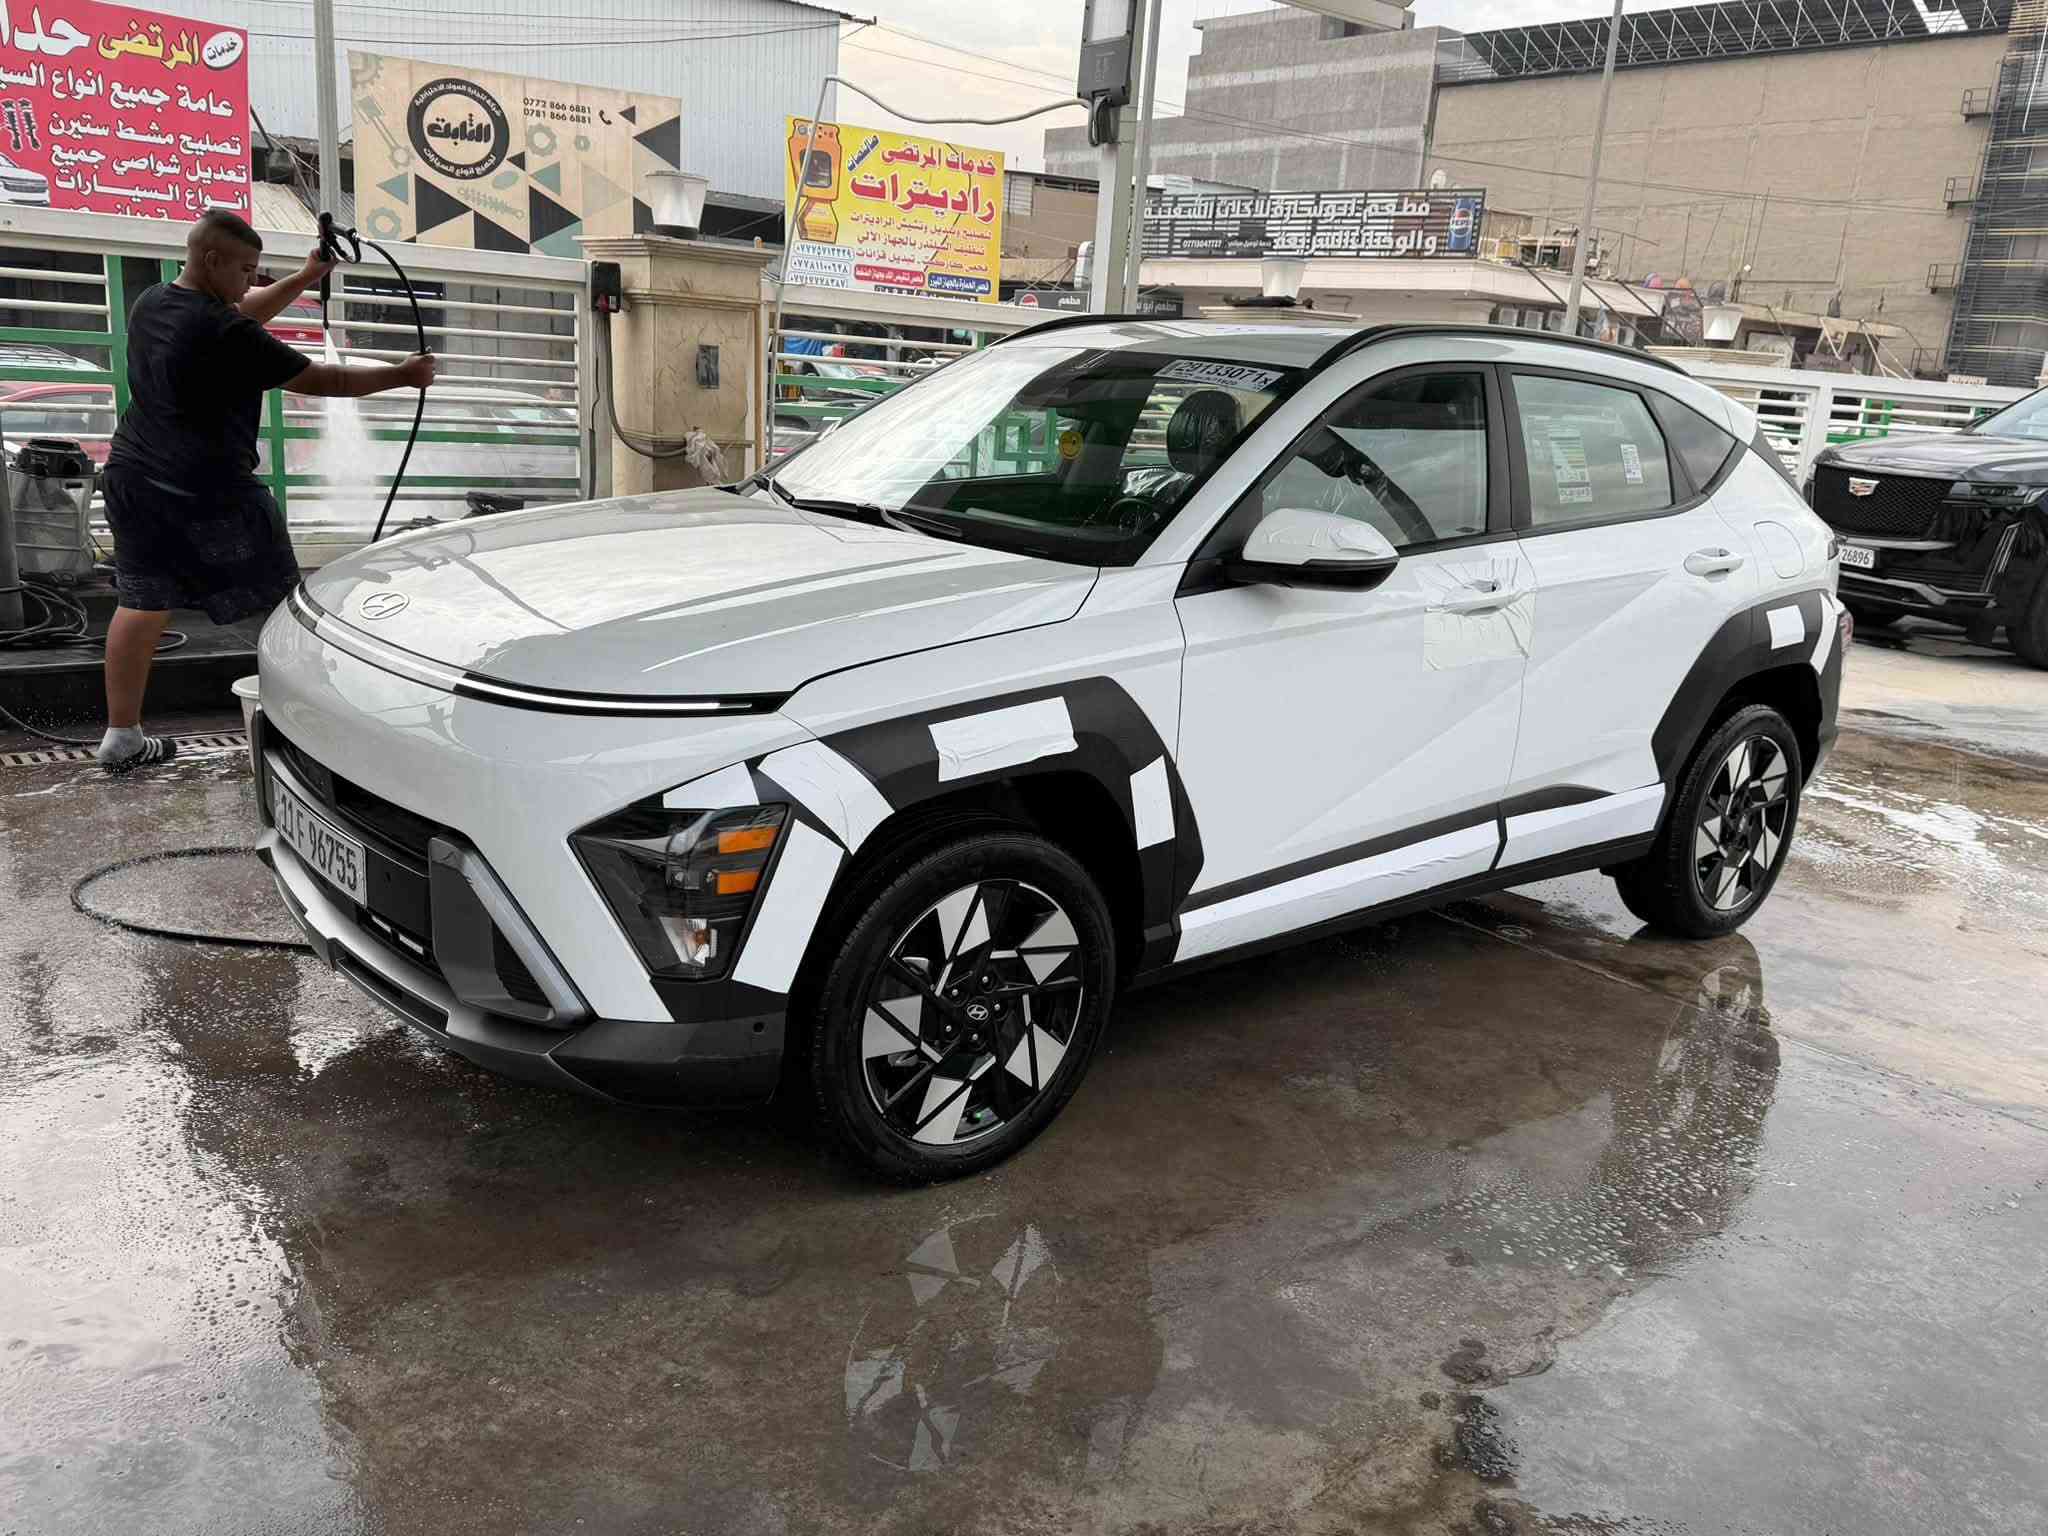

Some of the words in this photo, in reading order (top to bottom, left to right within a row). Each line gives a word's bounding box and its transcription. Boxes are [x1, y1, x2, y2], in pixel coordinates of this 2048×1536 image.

[97, 18, 200, 70] المرتضى
[207, 37, 238, 61] خدمات
[51, 68, 104, 99] انواع
[110, 81, 170, 112] جميع
[176, 84, 234, 117] عامة
[116, 119, 174, 145] مشط
[426, 113, 491, 146] الثابت
[51, 145, 106, 168] جميع
[179, 132, 241, 156] تصليح
[882, 141, 941, 169] المرتضى
[112, 153, 180, 177] شواصي
[186, 161, 248, 183] تعديل
[945, 151, 996, 176] خدمات
[1363, 197, 1430, 223] مطعم
[1841, 549, 1870, 565] 26896
[308, 820, 357, 891] 96755
